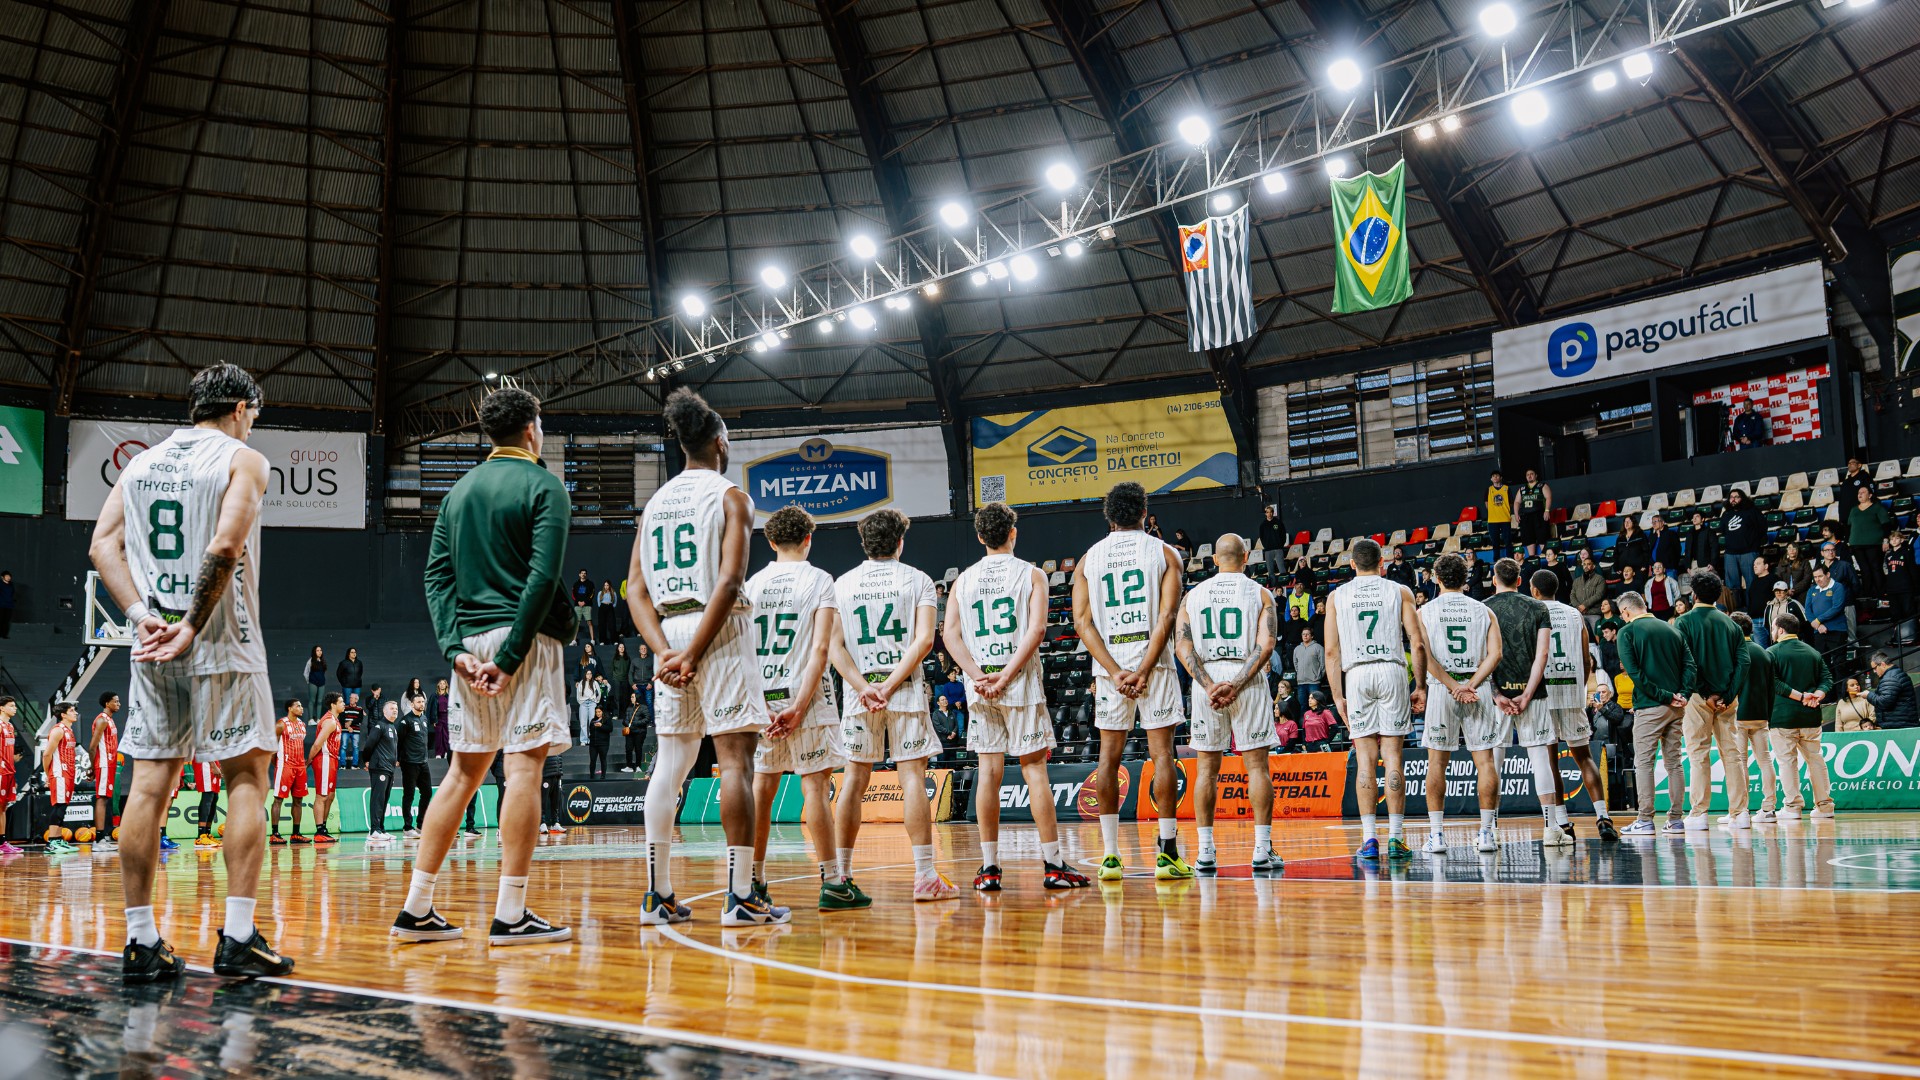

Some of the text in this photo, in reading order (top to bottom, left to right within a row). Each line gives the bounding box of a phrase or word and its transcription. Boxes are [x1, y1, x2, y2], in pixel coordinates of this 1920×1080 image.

[1605, 292, 1758, 361] pagoufácil
[1167, 400, 1221, 415] (14) 2106-950
[1106, 431, 1165, 443] Na Concreto
[805, 443, 826, 458] M
[1106, 442, 1159, 456] seu imóvel
[290, 449, 338, 465] grupo
[1107, 452, 1181, 471] DÁ CERTO!
[790, 464, 817, 473] desde
[1028, 465, 1098, 480] CONCRETO
[264, 466, 338, 496] nus
[760, 470, 877, 498] MEZZANI
[286, 499, 338, 509] SOLUÇÕES
[652, 508, 696, 521] RODRIGUES
[148, 499, 184, 560] 8
[651, 522, 698, 571] 16
[1108, 550, 1137, 558] ecovita
[1107, 559, 1137, 569] BORGES
[859, 579, 893, 588] ecovita
[979, 586, 1005, 595] BRAGA
[1101, 568, 1146, 608] 12
[853, 590, 900, 601] MICHELINI
[1351, 600, 1383, 608] GUSTAVO
[853, 603, 908, 645] 14
[971, 597, 1018, 637] 13
[1200, 607, 1243, 640] 10
[1358, 610, 1379, 640] 7
[754, 613, 799, 656] 15
[1446, 625, 1468, 654] 5
[1550, 631, 1566, 658] 1
[876, 650, 902, 665] GH
[724, 704, 744, 716] SPSP
[223, 724, 251, 739] SPSP
[522, 721, 546, 735] SPSP
[807, 748, 826, 762] SPSP
[1272, 771, 1328, 782] PAULISTA
[1405, 780, 1419, 795] DO
[1500, 778, 1529, 795] LISTA
[1830, 778, 1903, 791] COMÉRCIO
[569, 800, 590, 808] FPB
[594, 795, 633, 804] FEDERAÇÃO
[862, 793, 904, 803] SKETBALL
[593, 803, 645, 813] DE BASKETB
